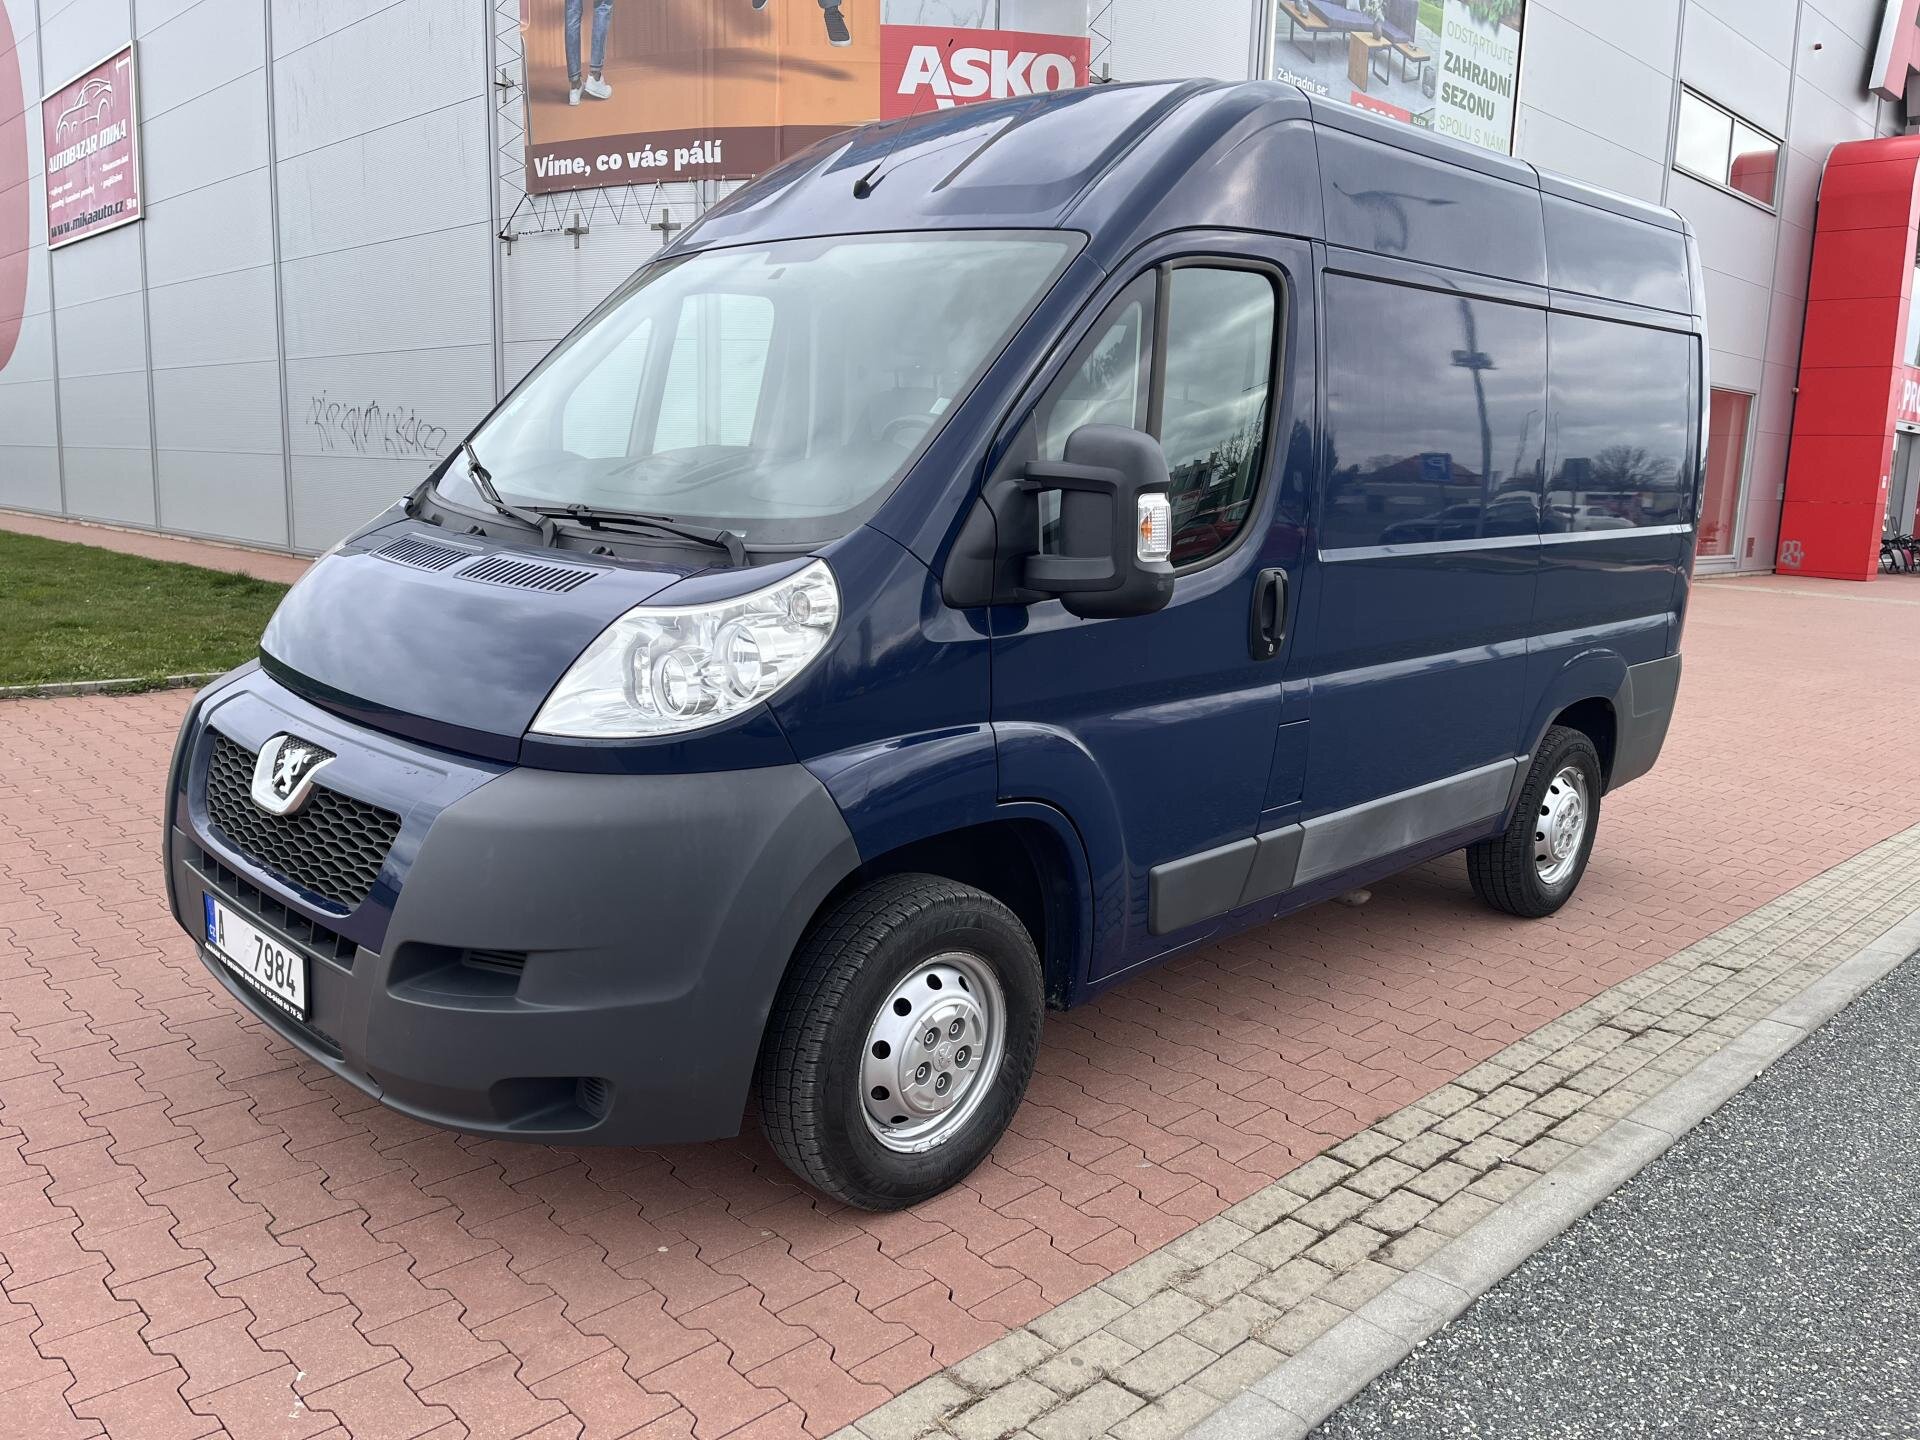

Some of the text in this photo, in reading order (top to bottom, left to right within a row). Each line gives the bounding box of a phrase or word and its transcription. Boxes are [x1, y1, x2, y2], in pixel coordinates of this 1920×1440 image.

[1446, 20, 1514, 66] ODSTARTUJTE
[897, 45, 1076, 98] ASKO
[1278, 67, 1315, 91] Zahradní
[1443, 49, 1513, 98] ZAHRADNÍ
[1441, 81, 1495, 121] SEZONU
[48, 136, 97, 175] AUTOBAZAR
[99, 118, 127, 148] MIKA
[1439, 114, 1472, 140] SPOLU
[1474, 128, 1481, 144] S
[533, 139, 722, 178] Víme, co vás pálí
[51, 199, 124, 238] www.mikaauto.cz
[218, 908, 226, 948] A
[254, 933, 296, 998] 7984
